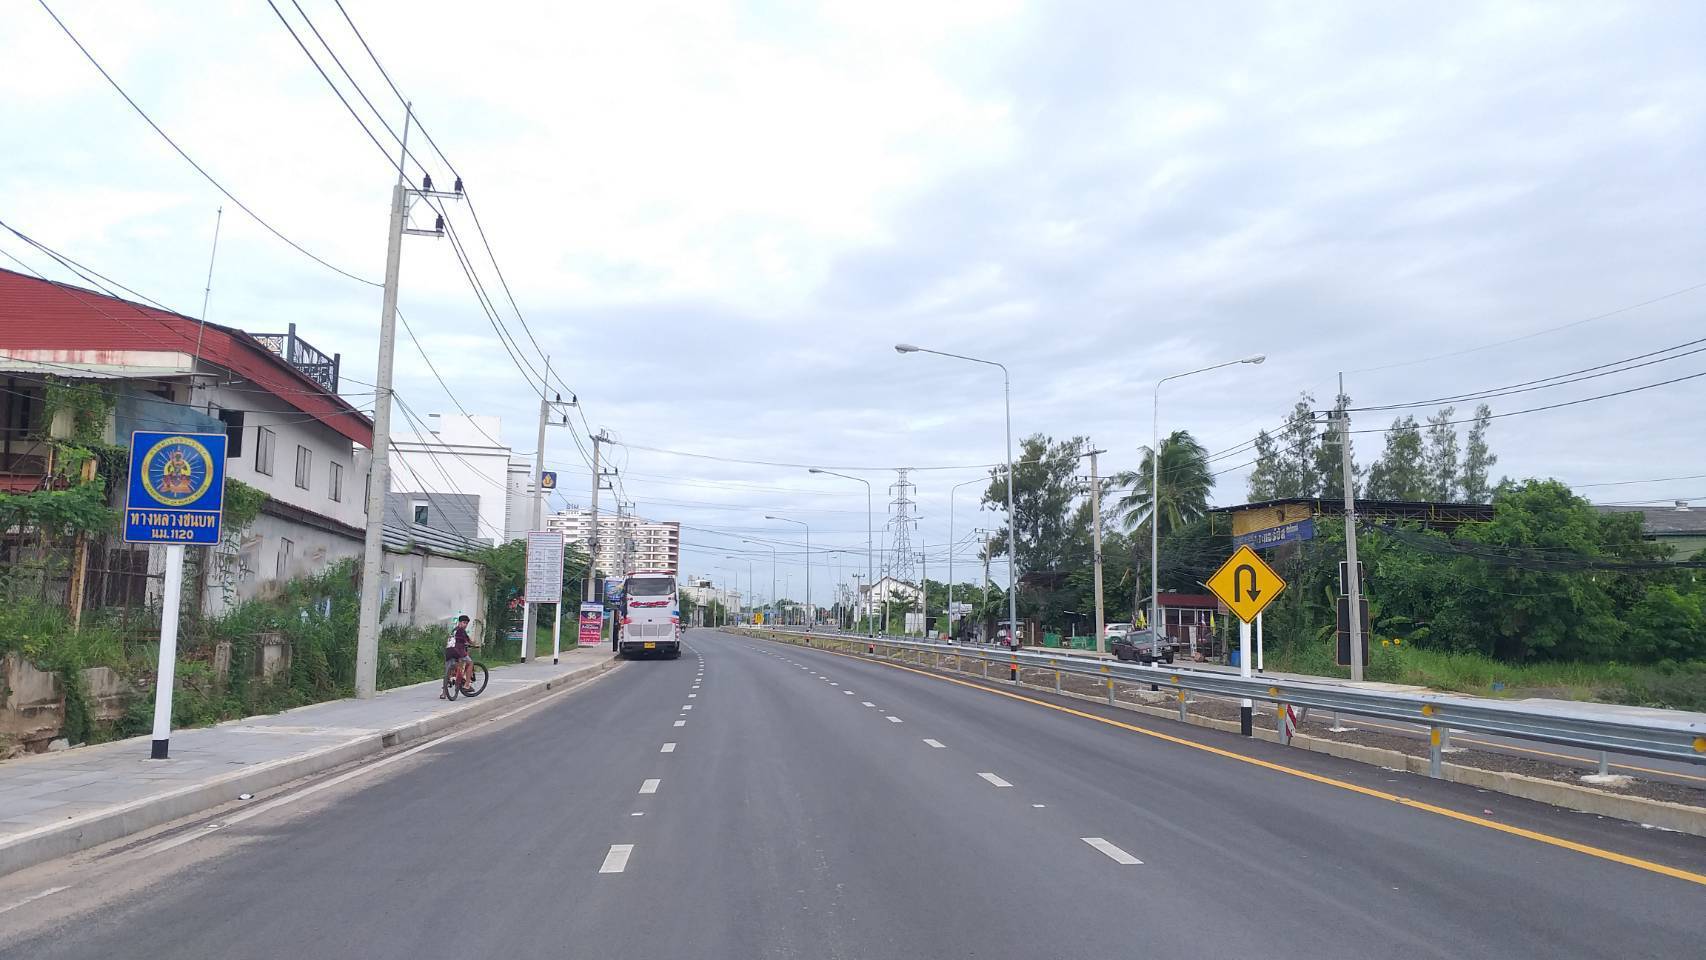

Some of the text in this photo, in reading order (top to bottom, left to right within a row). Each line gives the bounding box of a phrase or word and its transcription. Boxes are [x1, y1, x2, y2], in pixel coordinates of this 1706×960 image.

[130, 512, 215, 528] ทางหลวงชนบท
[151, 529, 194, 539] นม.1120
